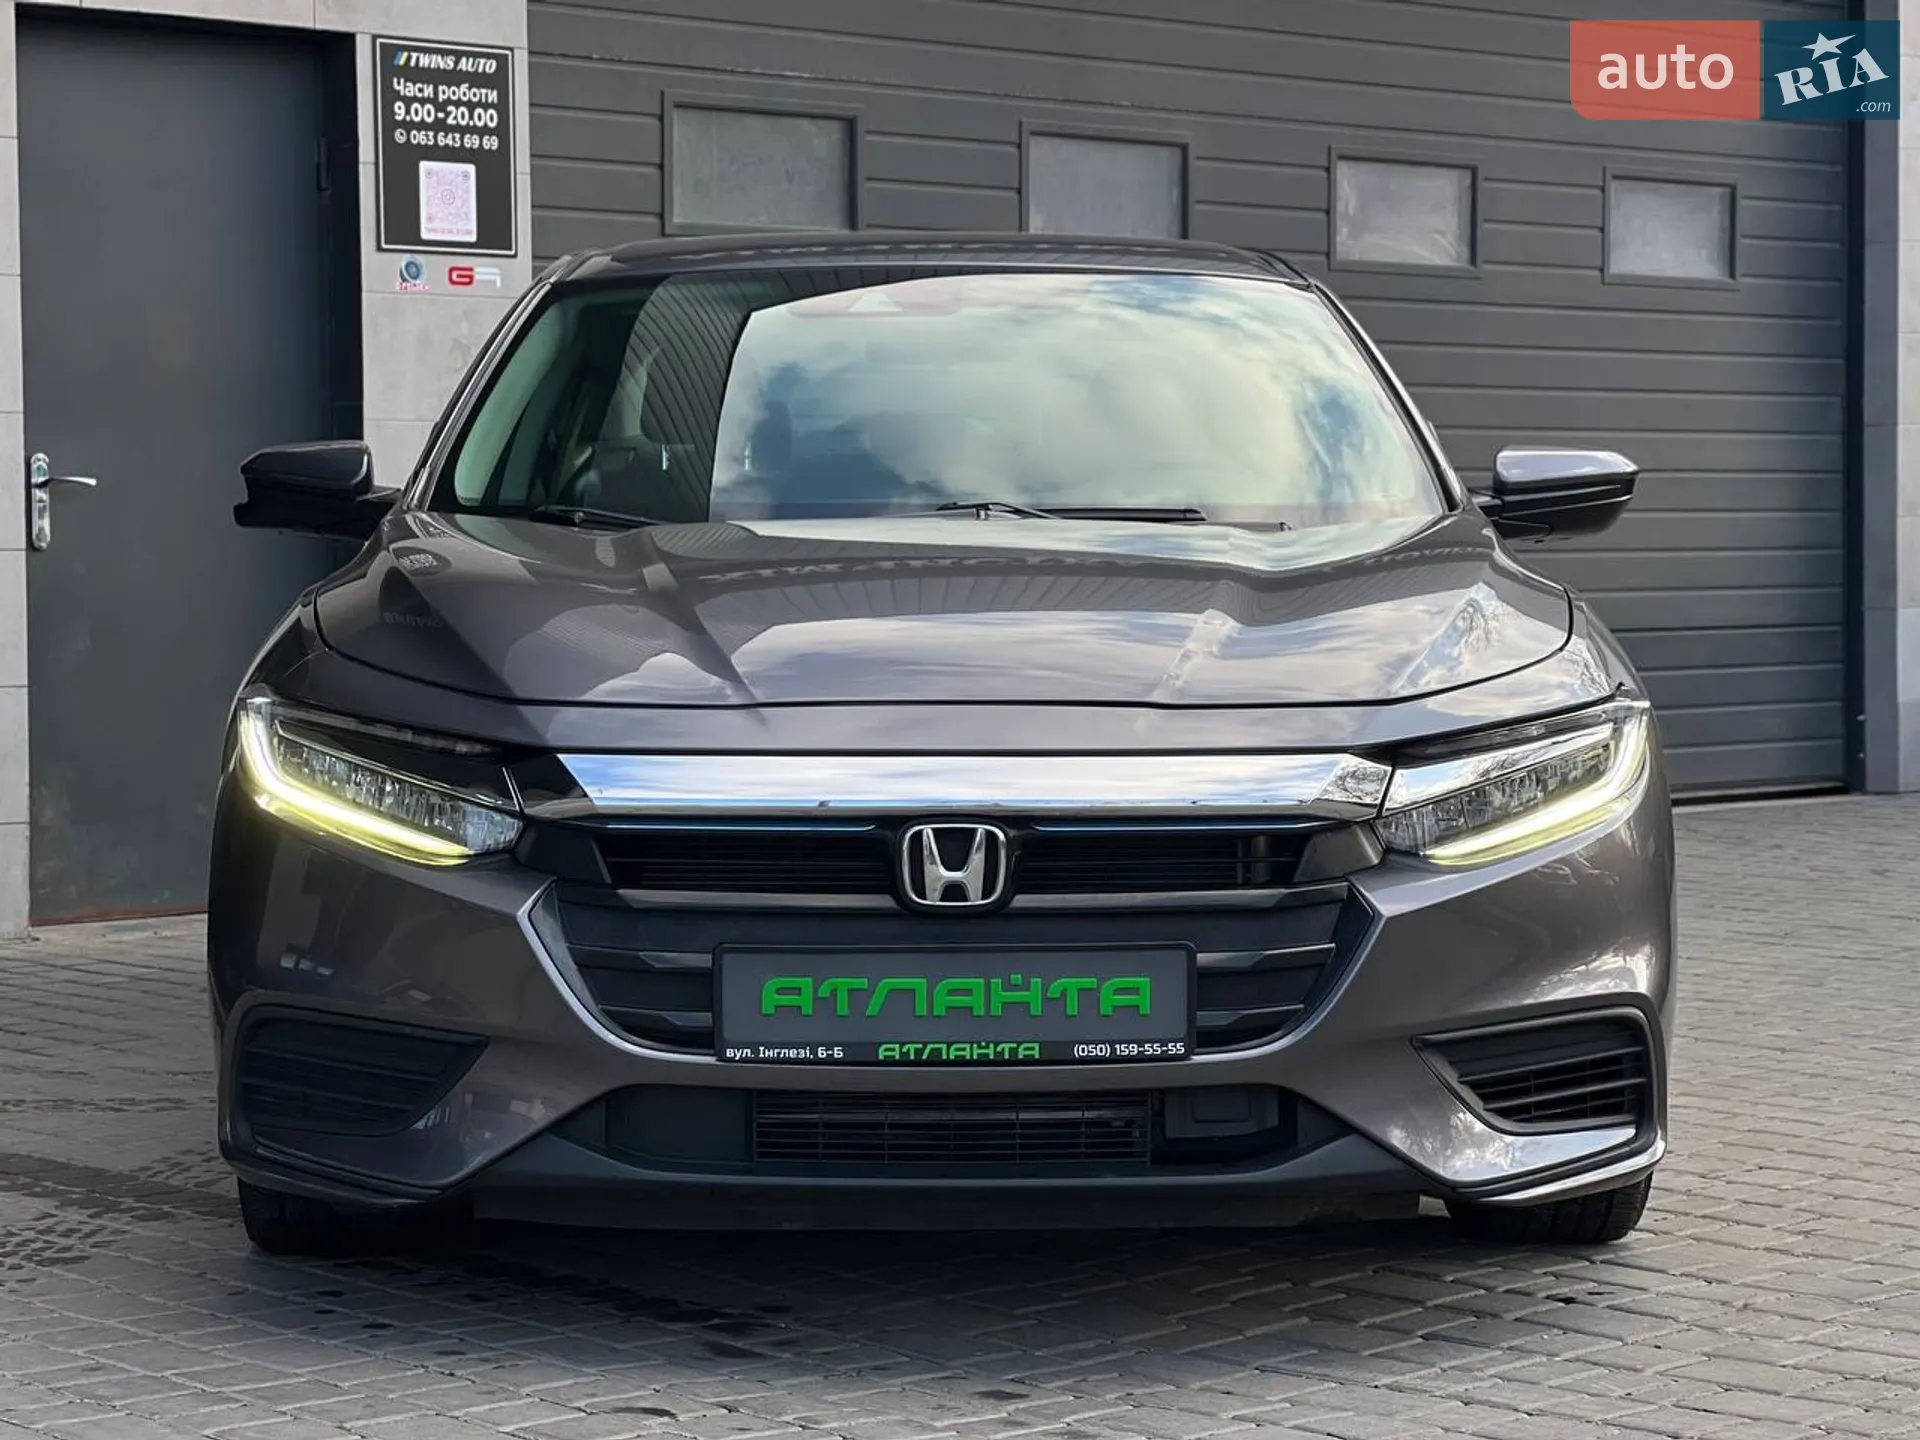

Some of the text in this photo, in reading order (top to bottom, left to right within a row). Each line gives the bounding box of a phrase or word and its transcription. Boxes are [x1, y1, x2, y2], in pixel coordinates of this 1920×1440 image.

[408, 51, 497, 74] TWINS AUTO
[392, 77, 498, 104] Часи роботи
[410, 129, 499, 151] 063 643 69 69
[725, 1047, 755, 1060] вул.
[758, 1046, 815, 1060] Інглезі,
[1073, 1042, 1185, 1058] (050) 159-55-55
